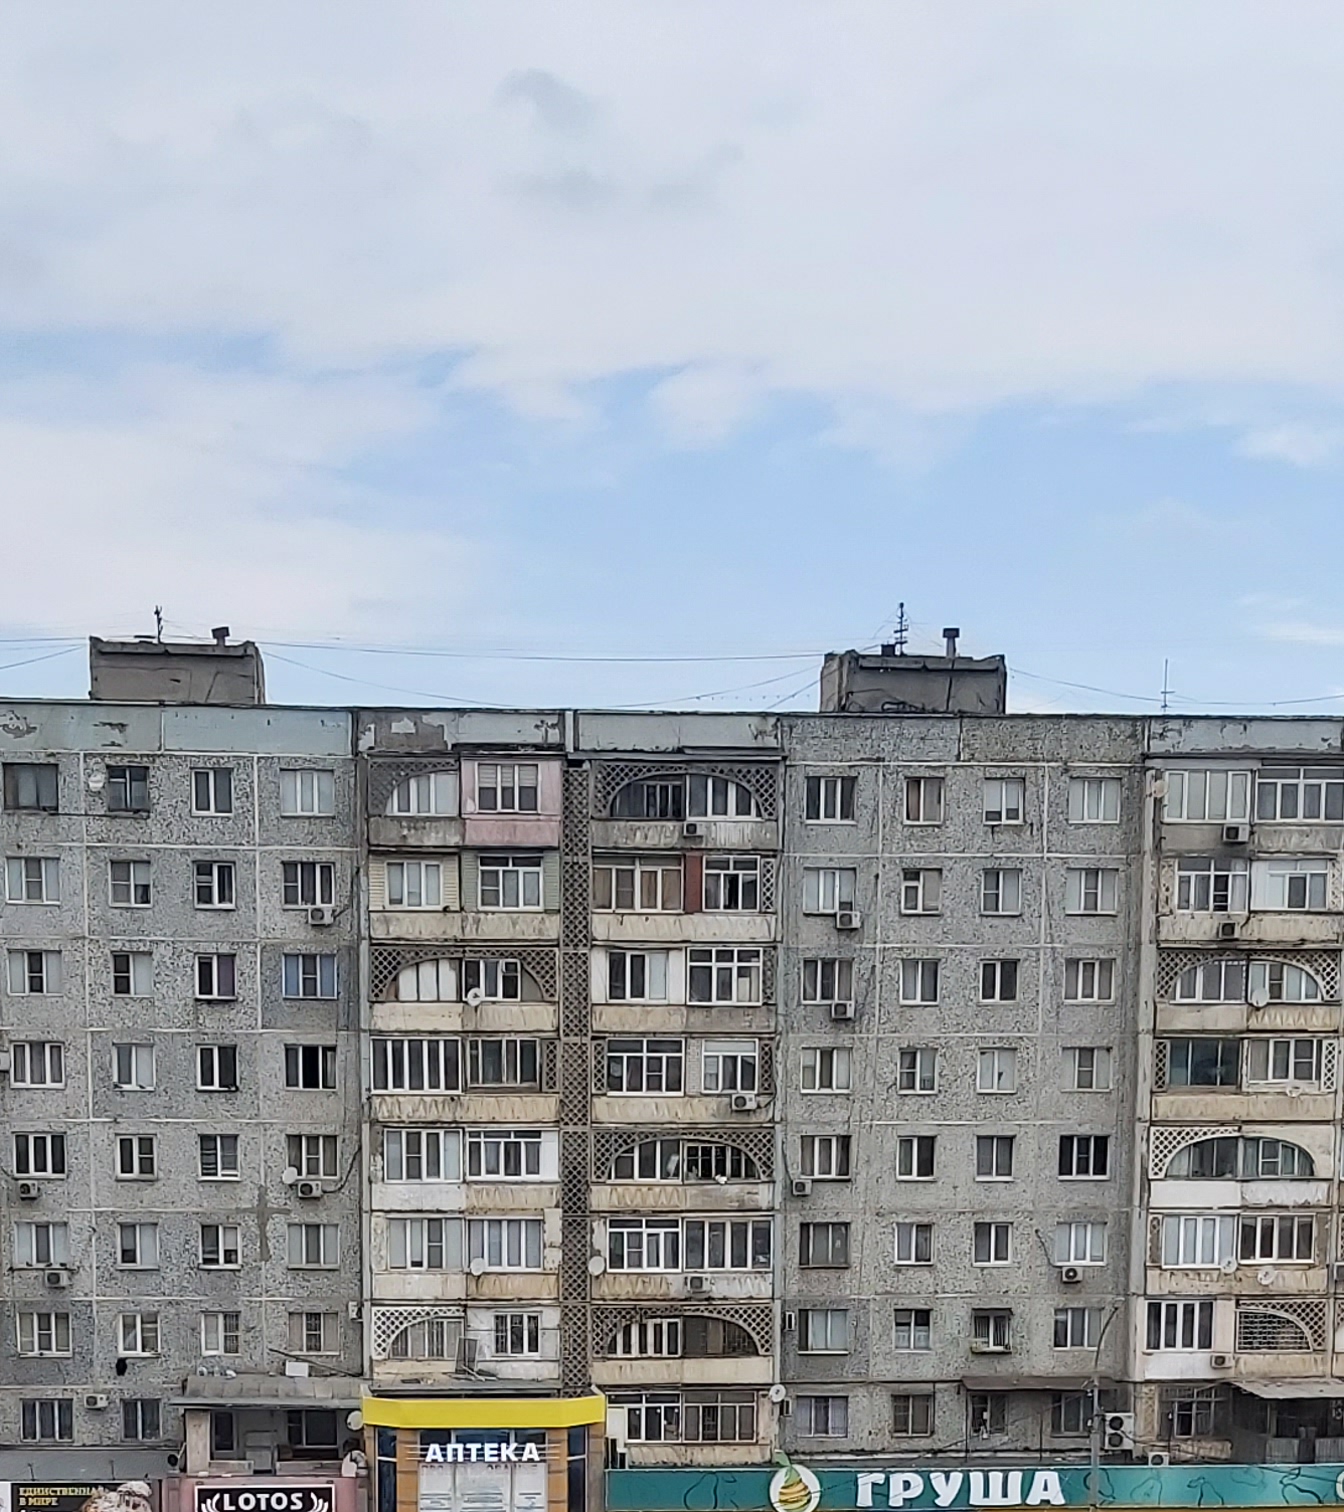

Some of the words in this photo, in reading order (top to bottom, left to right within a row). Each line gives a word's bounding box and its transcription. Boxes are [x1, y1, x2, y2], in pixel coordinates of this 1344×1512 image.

[425, 1442, 540, 1463] АПТЕКА
[855, 1470, 1066, 1508] ГРУША
[28, 1497, 59, 1506] МИРЕ
[222, 1492, 304, 1511] LOTOS
